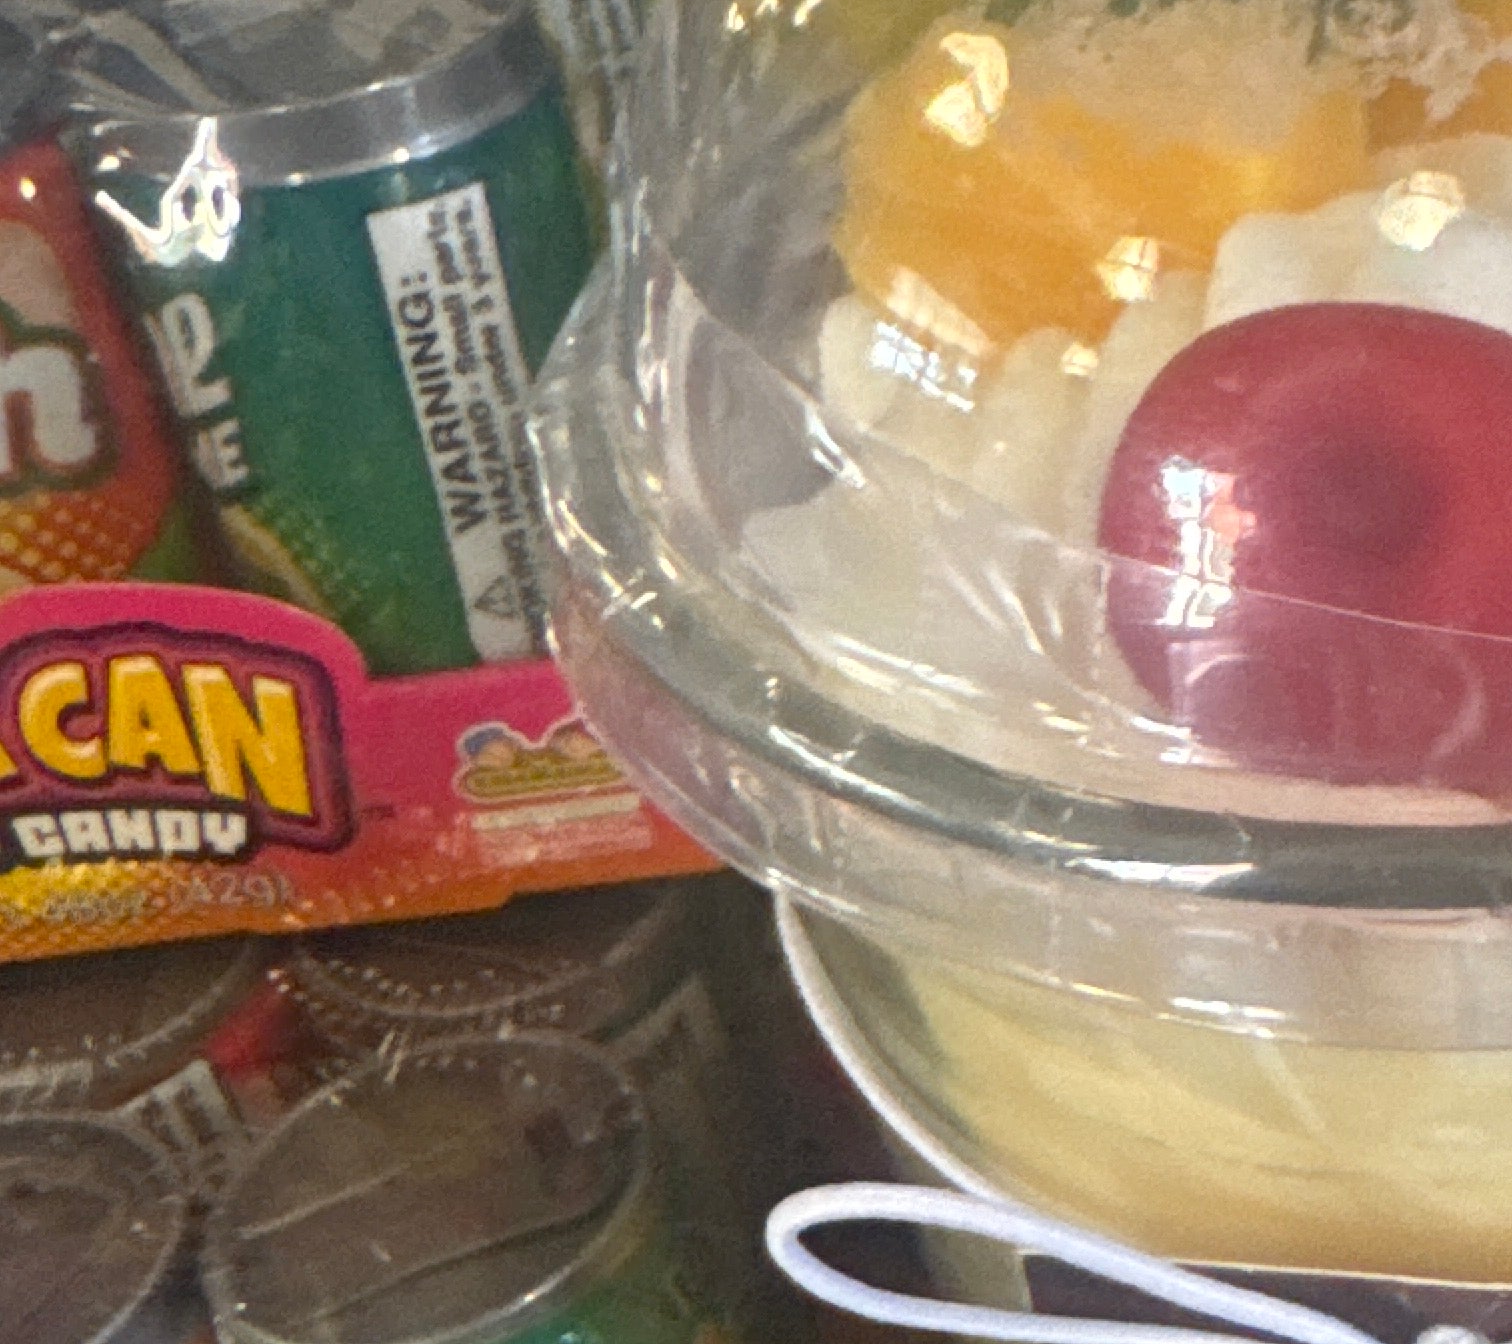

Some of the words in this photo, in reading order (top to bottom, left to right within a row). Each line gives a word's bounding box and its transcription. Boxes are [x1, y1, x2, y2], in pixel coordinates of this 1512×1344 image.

[400, 270, 489, 536] WARNING:
[17, 653, 313, 818] CAN
[11, 809, 248, 858] CANDY
